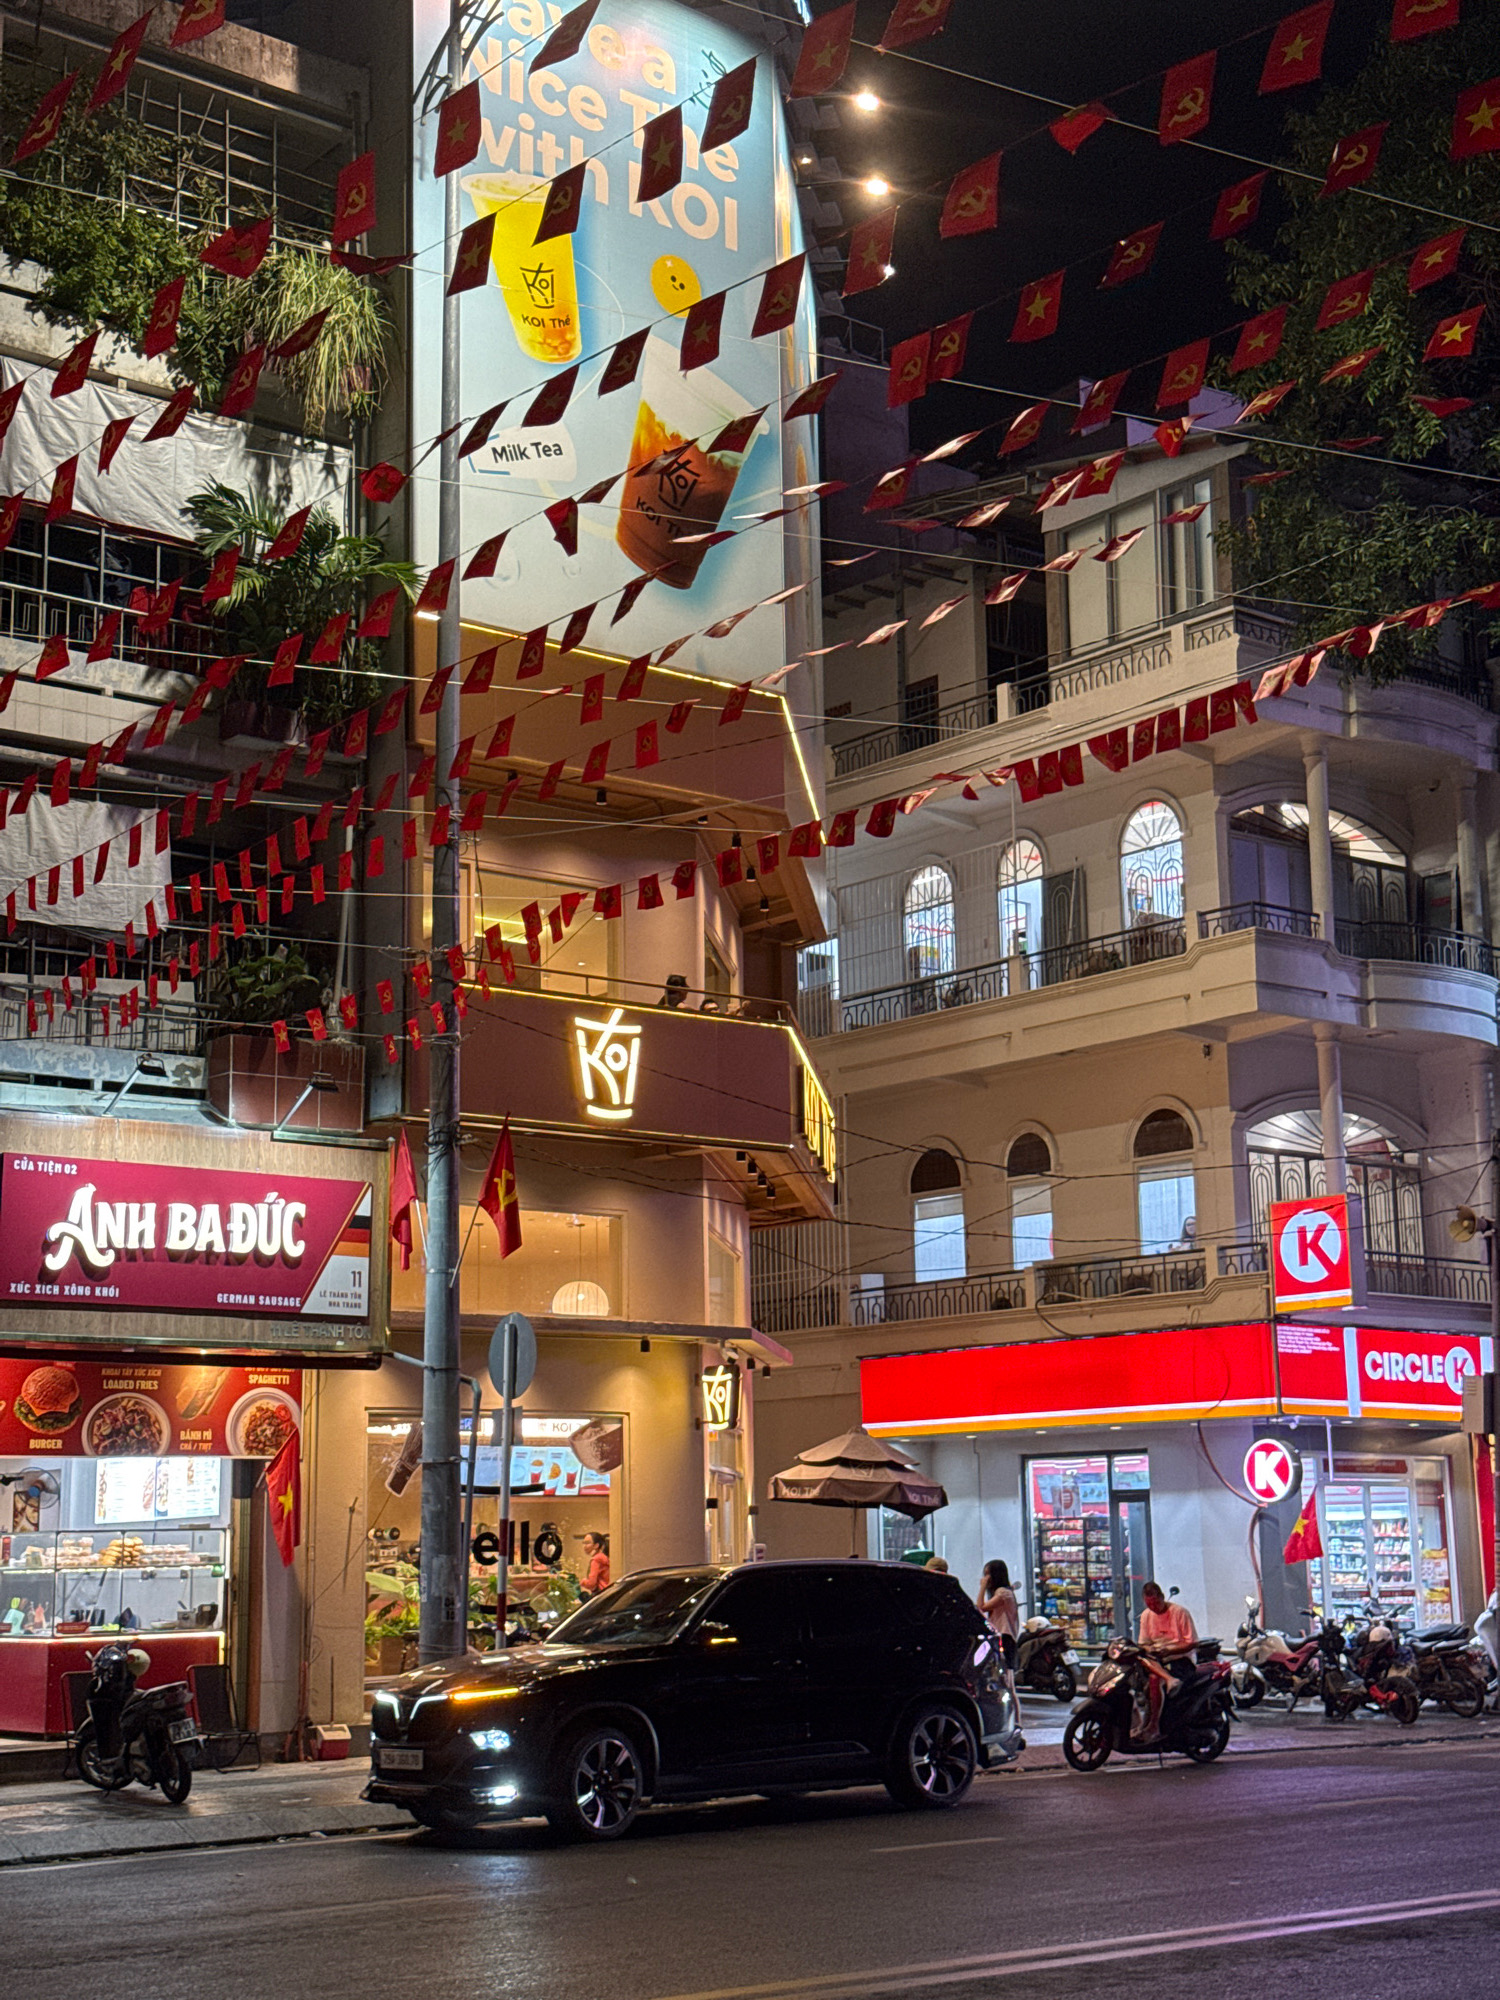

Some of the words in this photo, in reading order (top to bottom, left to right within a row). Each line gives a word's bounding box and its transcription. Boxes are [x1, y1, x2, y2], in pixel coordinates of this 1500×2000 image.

[641, 44, 677, 96] a
[462, 33, 608, 131] Nice
[628, 160, 738, 252] KOI
[521, 313, 546, 329] KOI
[548, 314, 572, 329] Thé
[491, 442, 532, 464] Milk
[529, 441, 564, 459] Tea
[635, 495, 663, 527] KOI
[63, 1163, 79, 1176] 02
[44, 1182, 157, 1272] ANH
[164, 1202, 227, 1253] BA
[1297, 1221, 1337, 1275] K
[9, 1280, 31, 1294] XÚC
[63, 1283, 92, 1297] XÔNG
[94, 1285, 120, 1298] KHÓI
[350, 1270, 363, 1288] 11
[216, 1292, 256, 1305] GERMAN
[258, 1295, 302, 1308] SAUSAGE
[1364, 1350, 1445, 1384] CIRCLE
[102, 1379, 135, 1390] LOADED
[135, 1379, 159, 1390] FRIES
[248, 1374, 290, 1385] SPAGHETTI
[552, 1422, 572, 1433] KOI
[29, 1438, 63, 1449] BURGER
[1254, 1451, 1287, 1498] K
[461, 1520, 563, 1567] ello
